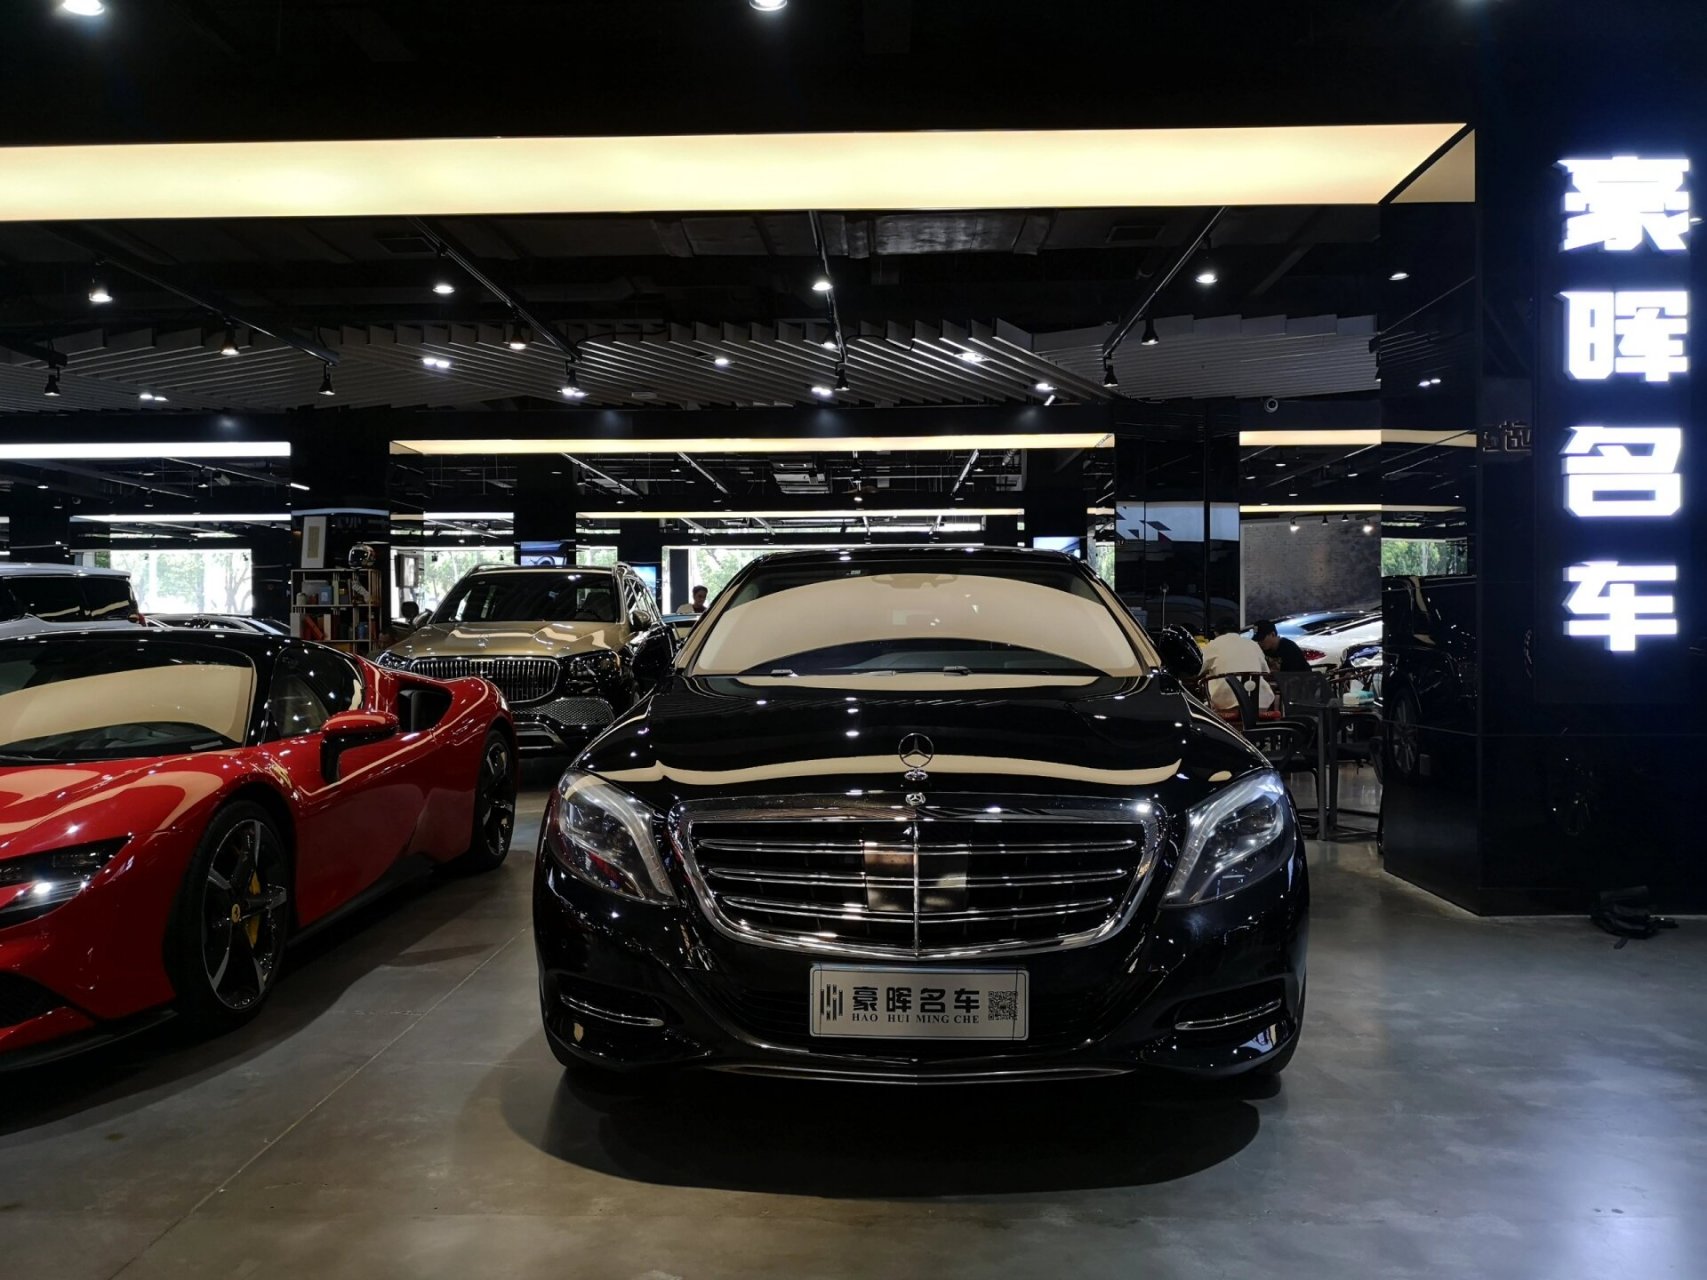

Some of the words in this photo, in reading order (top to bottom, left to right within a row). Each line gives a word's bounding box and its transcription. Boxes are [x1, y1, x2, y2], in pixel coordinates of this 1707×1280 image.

[1556, 156, 1691, 653] 豪晖名车
[852, 986, 980, 1013] 豪晖名车
[852, 1013, 879, 1022] HAO
[887, 1014, 910, 1023] HUI
[916, 1014, 949, 1024] MING
[953, 1015, 980, 1024] CHE
